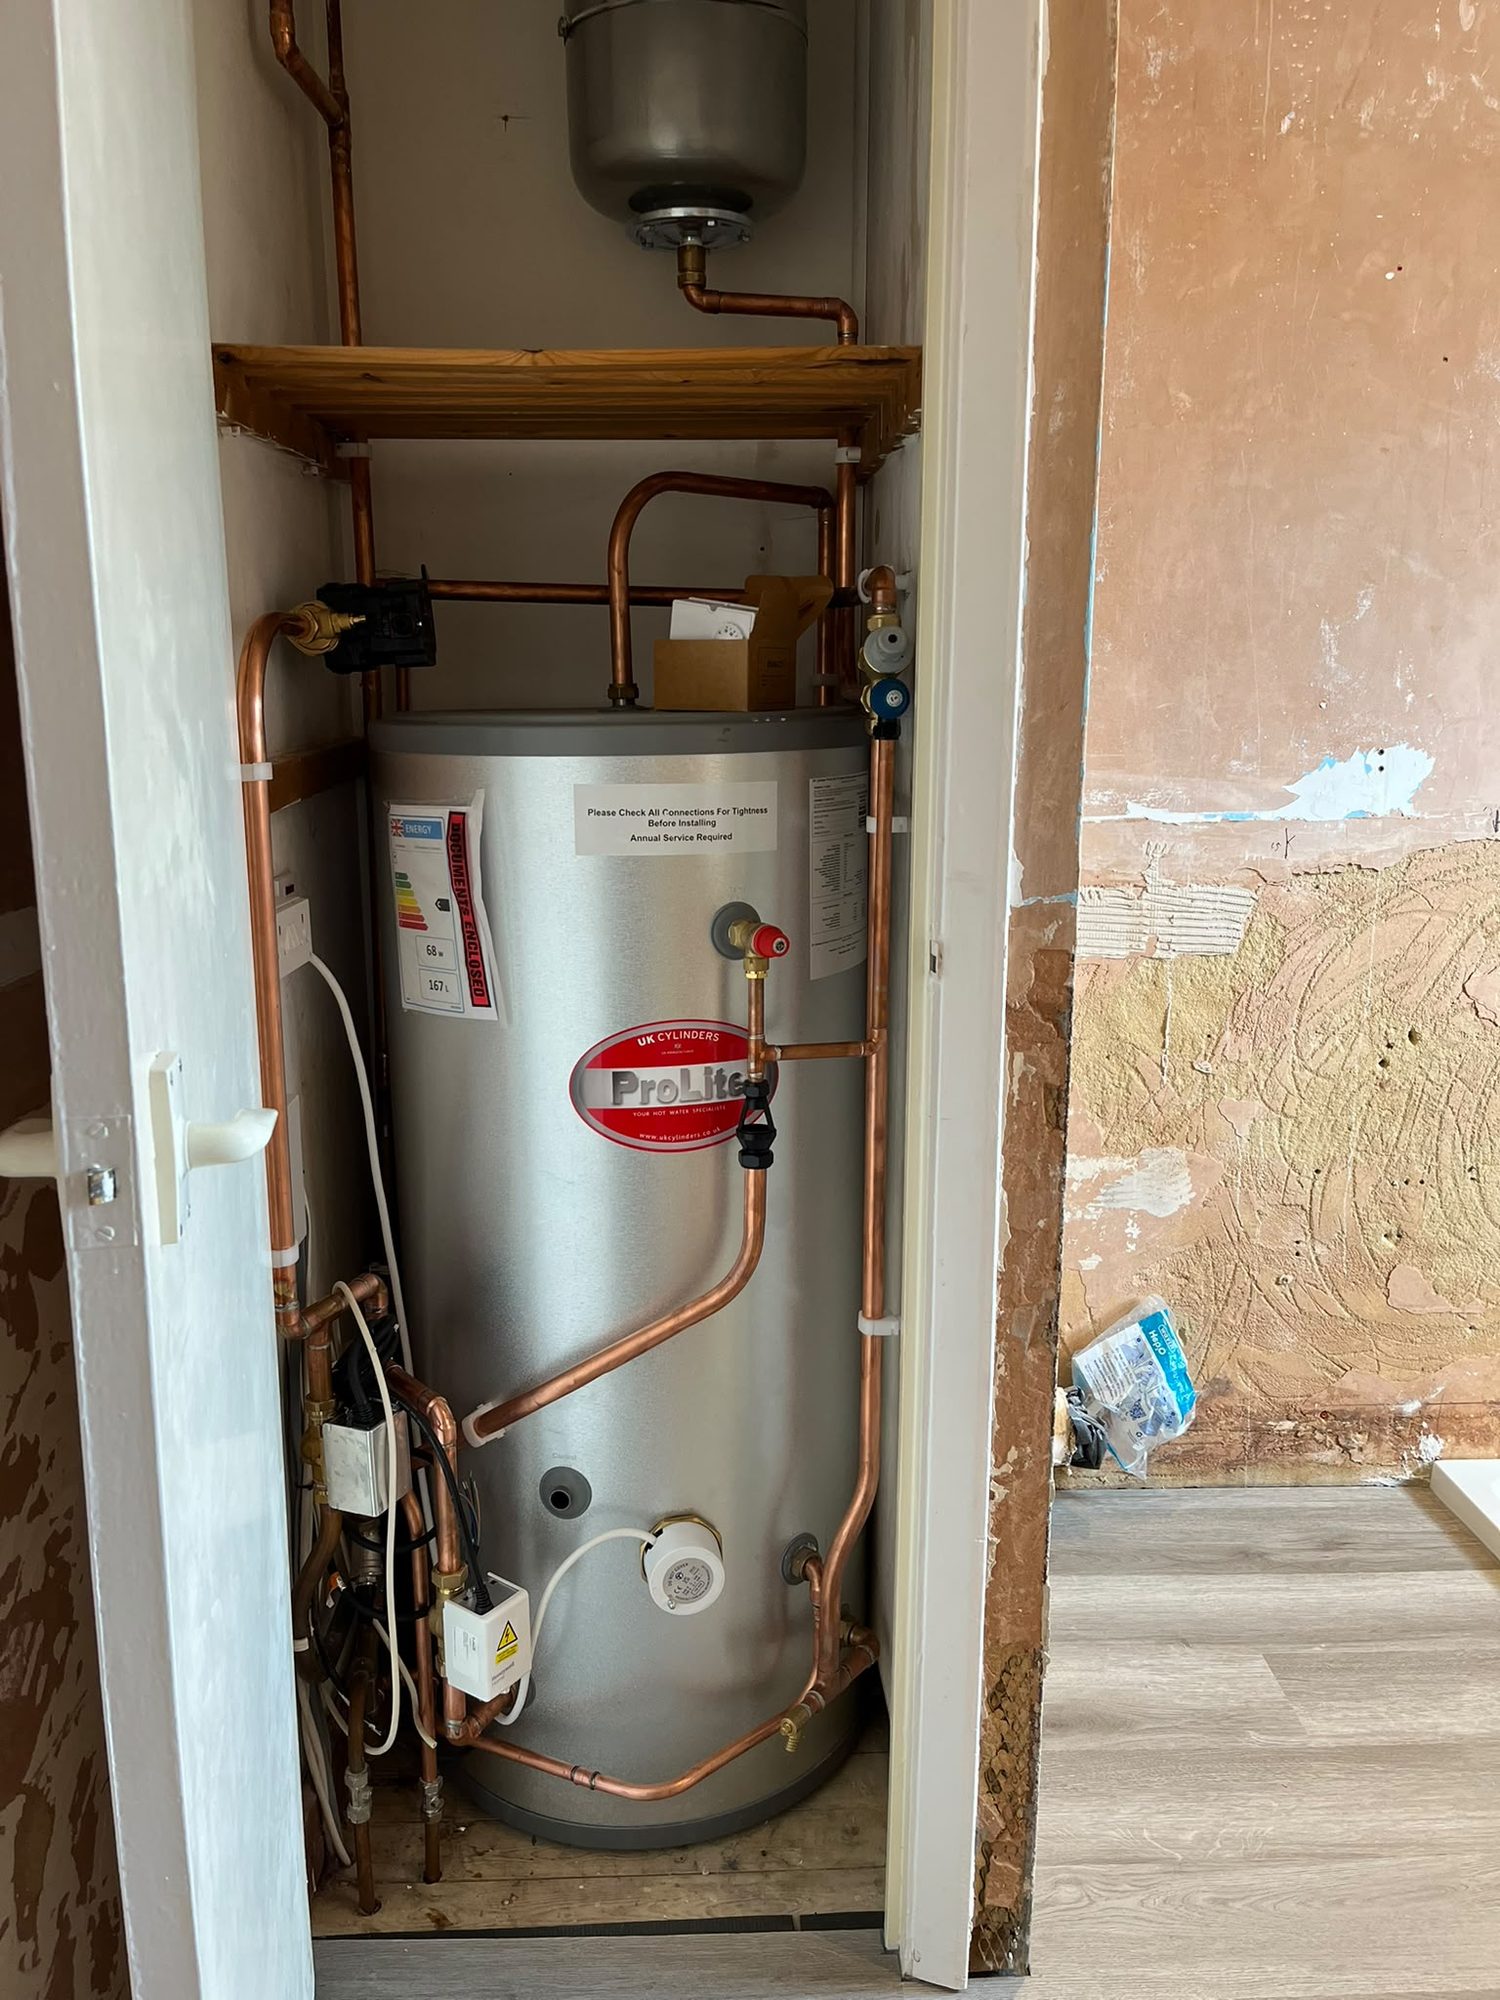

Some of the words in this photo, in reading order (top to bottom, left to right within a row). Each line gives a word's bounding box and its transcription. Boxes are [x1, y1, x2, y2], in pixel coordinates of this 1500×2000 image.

[587, 808, 617, 817] Please
[618, 808, 646, 817] Check
[648, 808, 660, 817] All
[662, 808, 715, 817] Connections
[716, 807, 731, 816] For
[732, 807, 768, 817] Tightness
[405, 824, 432, 835] ENERGY
[648, 819, 677, 827] Before
[678, 819, 717, 828] Installing
[630, 834, 661, 842] Annual
[663, 833, 695, 842] Service
[696, 832, 733, 843] Required
[426, 944, 437, 957] 68
[464, 921, 486, 998] ENCLOSED
[428, 979, 444, 992] 167
[637, 1034, 656, 1047] UK
[657, 1030, 720, 1042] CYLINDERS
[611, 1066, 745, 1106] ProLite
